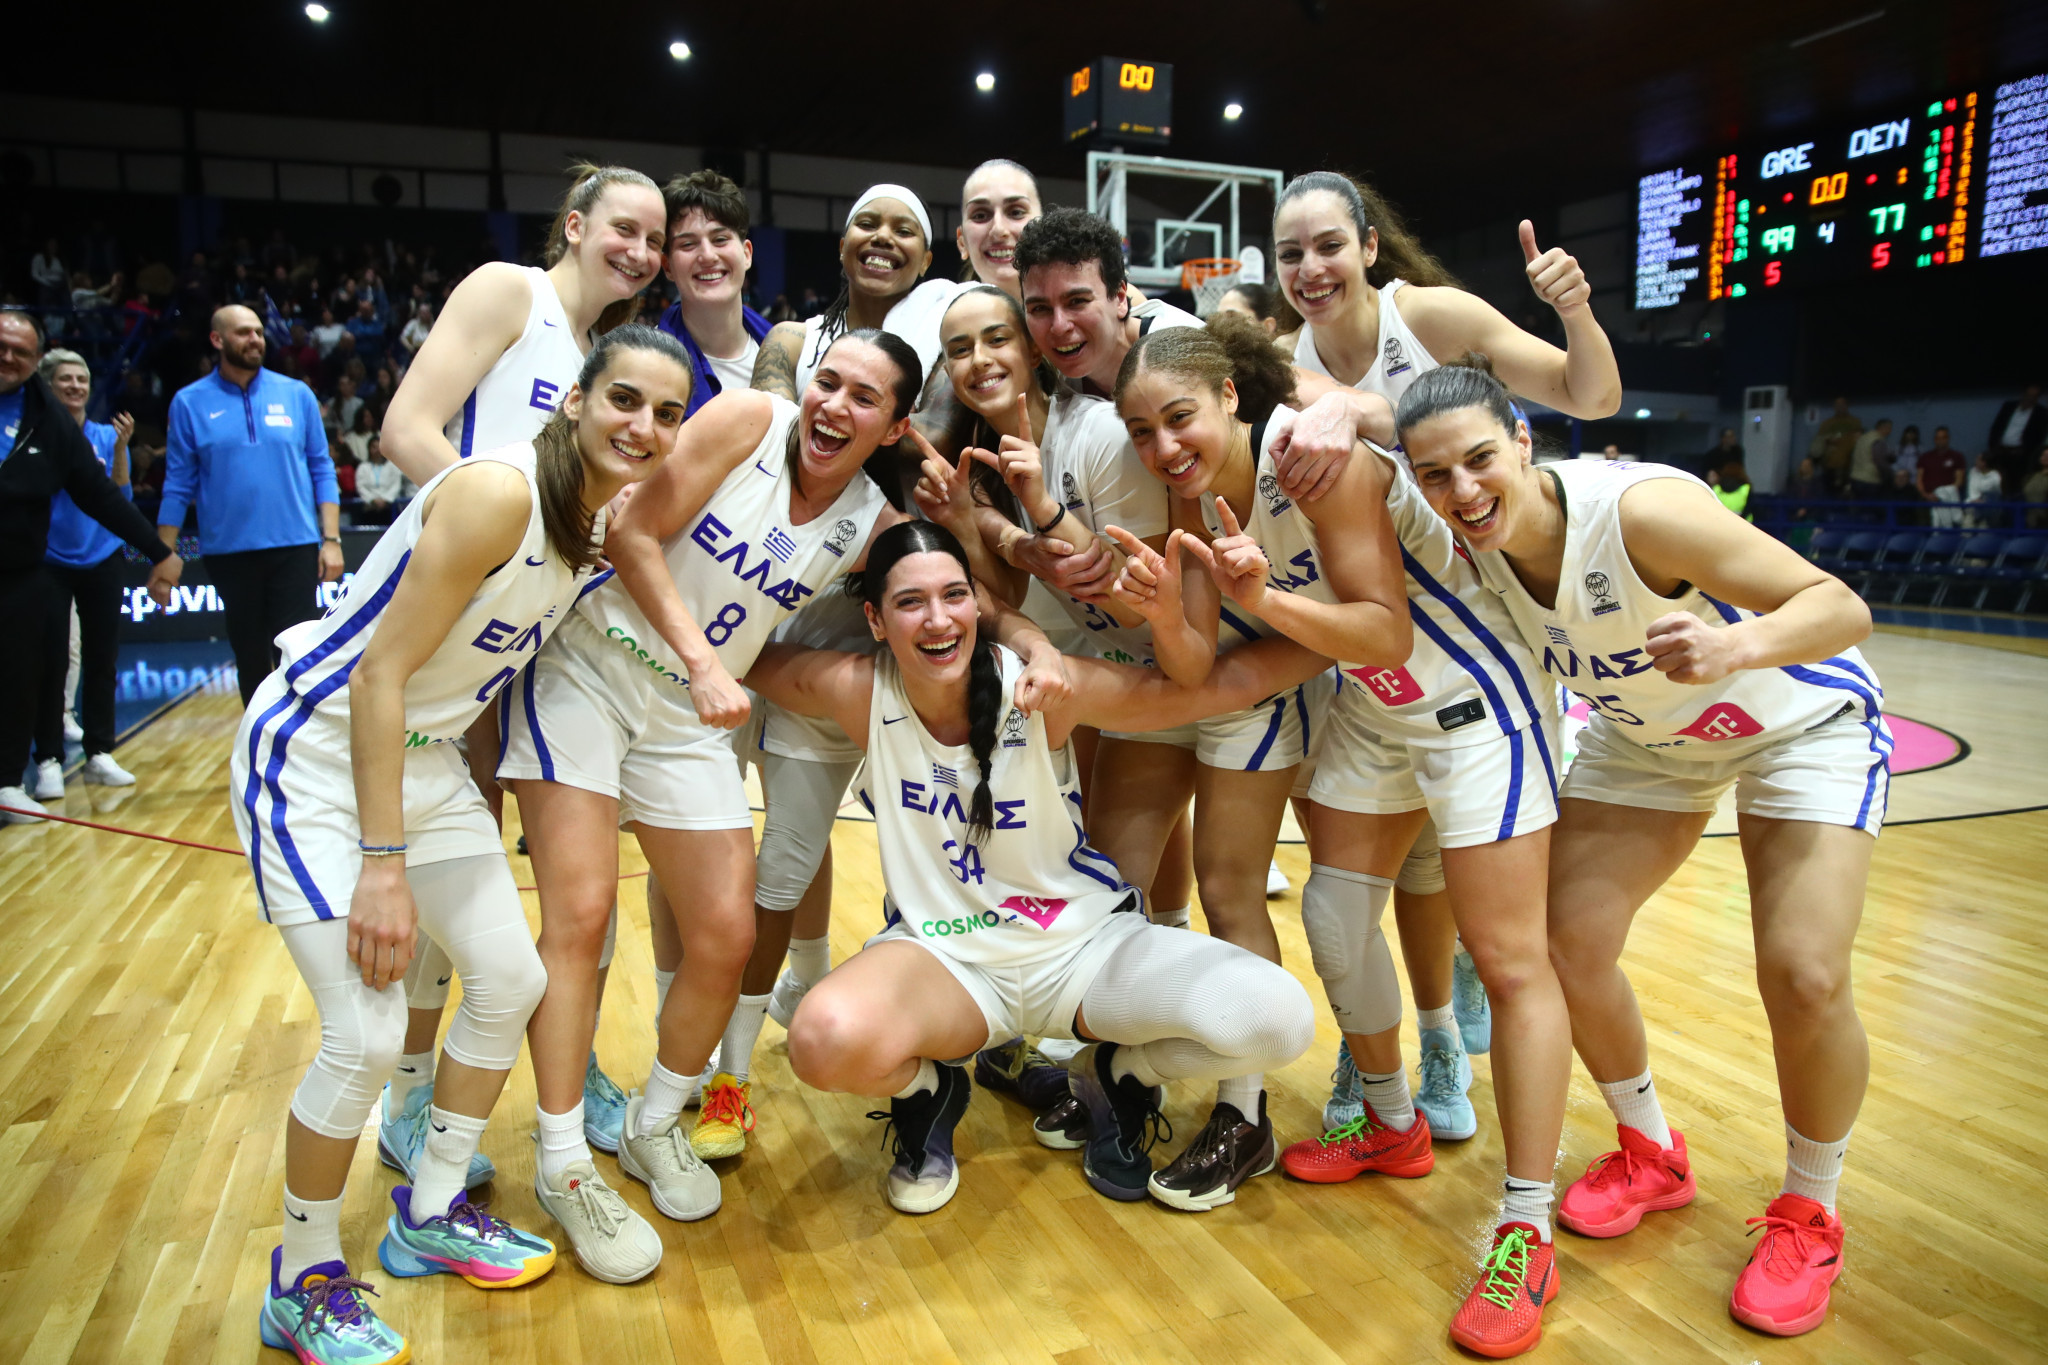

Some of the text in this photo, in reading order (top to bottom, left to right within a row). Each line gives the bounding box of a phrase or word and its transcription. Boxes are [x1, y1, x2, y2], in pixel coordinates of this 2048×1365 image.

[1848, 117, 1911, 159] DEN
[1761, 141, 1815, 180] GRE
[1817, 221, 1836, 244] 4
[1869, 203, 1907, 235] 77
[1762, 224, 1796, 254] 99
[1871, 242, 1892, 269] 5
[1765, 260, 1783, 287] 5
[690, 512, 814, 612] ΕΛΛΑΣ
[704, 602, 747, 647] 8
[1469, 706, 1476, 715] L
[942, 840, 985, 885] 34
